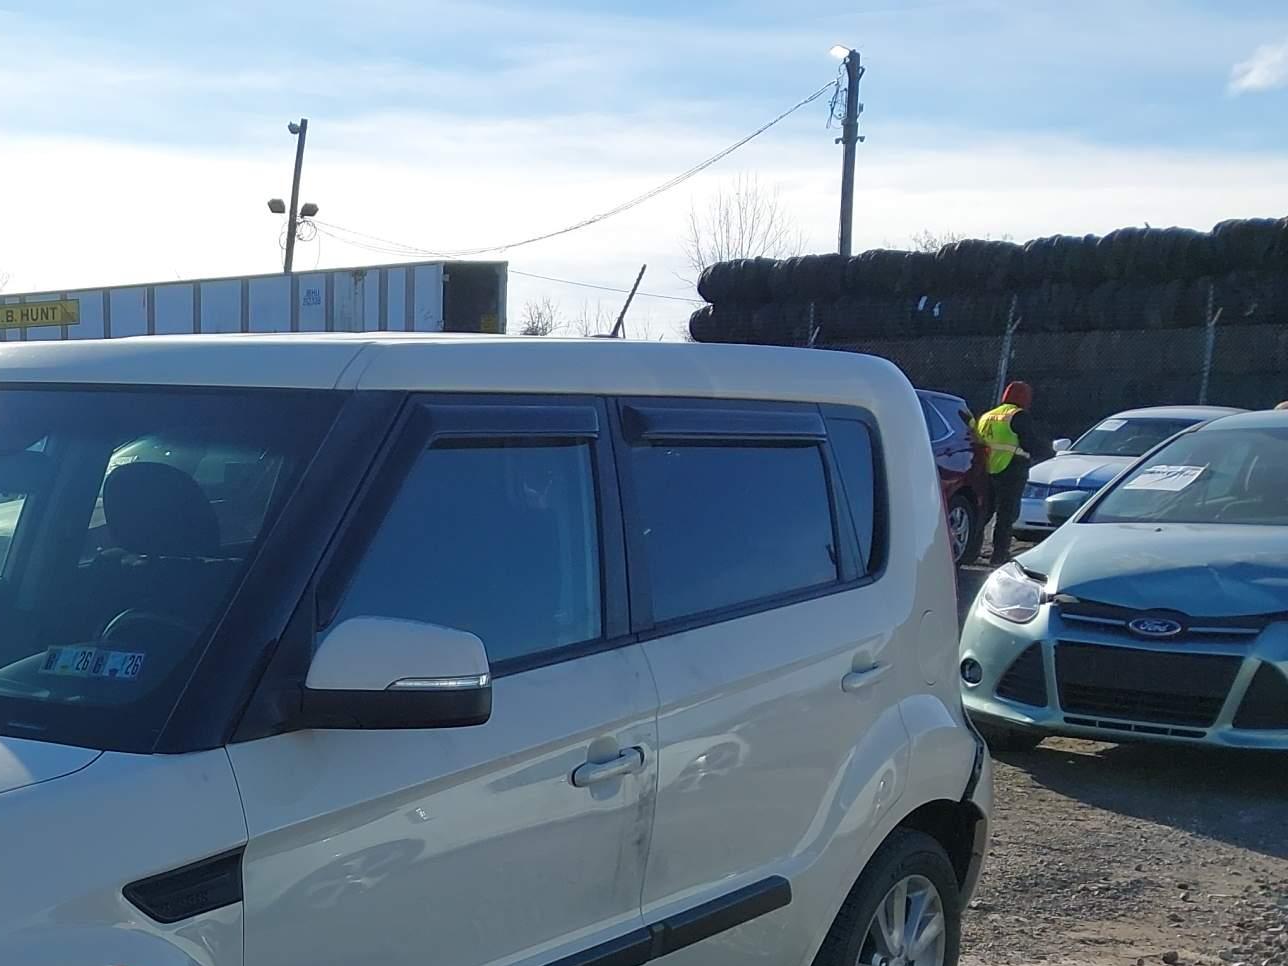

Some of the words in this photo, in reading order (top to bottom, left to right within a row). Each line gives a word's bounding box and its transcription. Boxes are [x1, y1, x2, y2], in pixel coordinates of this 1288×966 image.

[20, 306, 58, 322] HUNT
[1139, 620, 1170, 632] Ford
[75, 651, 94, 671] 26
[124, 655, 143, 676] 26
